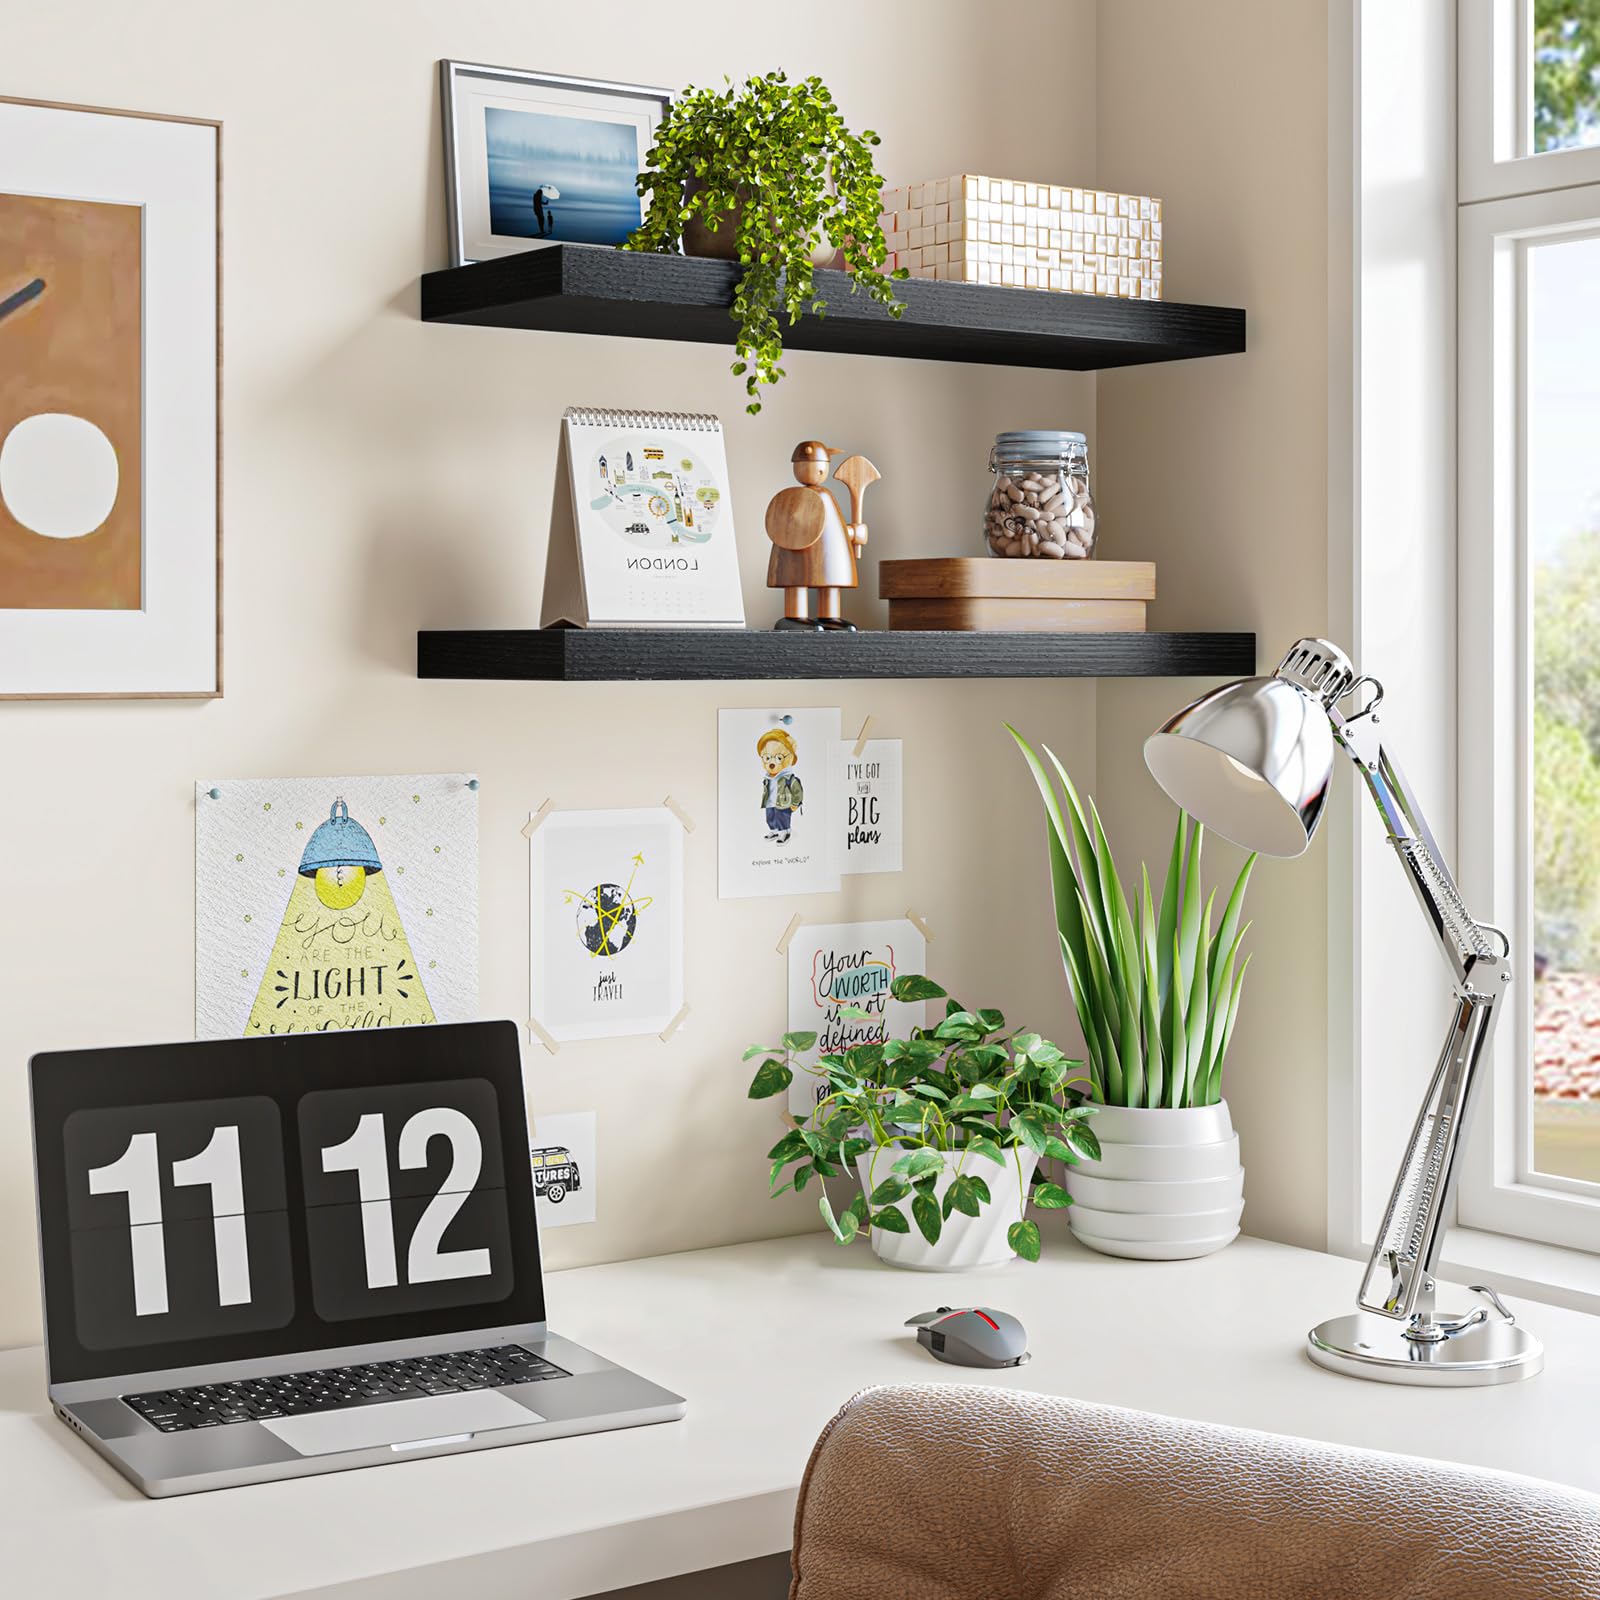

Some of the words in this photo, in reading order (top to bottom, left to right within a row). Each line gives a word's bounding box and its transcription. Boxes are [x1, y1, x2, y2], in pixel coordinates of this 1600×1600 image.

[847, 763, 862, 780] I'VE
[865, 762, 880, 779] GOT
[848, 796, 880, 826] BIG
[847, 825, 881, 850] plans
[281, 911, 408, 950] you
[300, 949, 332, 964] ARE
[344, 945, 373, 960] THE
[294, 965, 389, 1000] LIGHT
[598, 970, 617, 987] just
[819, 950, 873, 998] Your
[835, 968, 888, 999] WORTH
[593, 983, 623, 1001] TRAVEL
[308, 1004, 325, 1016] OF
[340, 1001, 366, 1014] THE
[819, 1018, 890, 1055] defined
[88, 1125, 252, 1317] 11
[320, 1107, 492, 1289] 12
